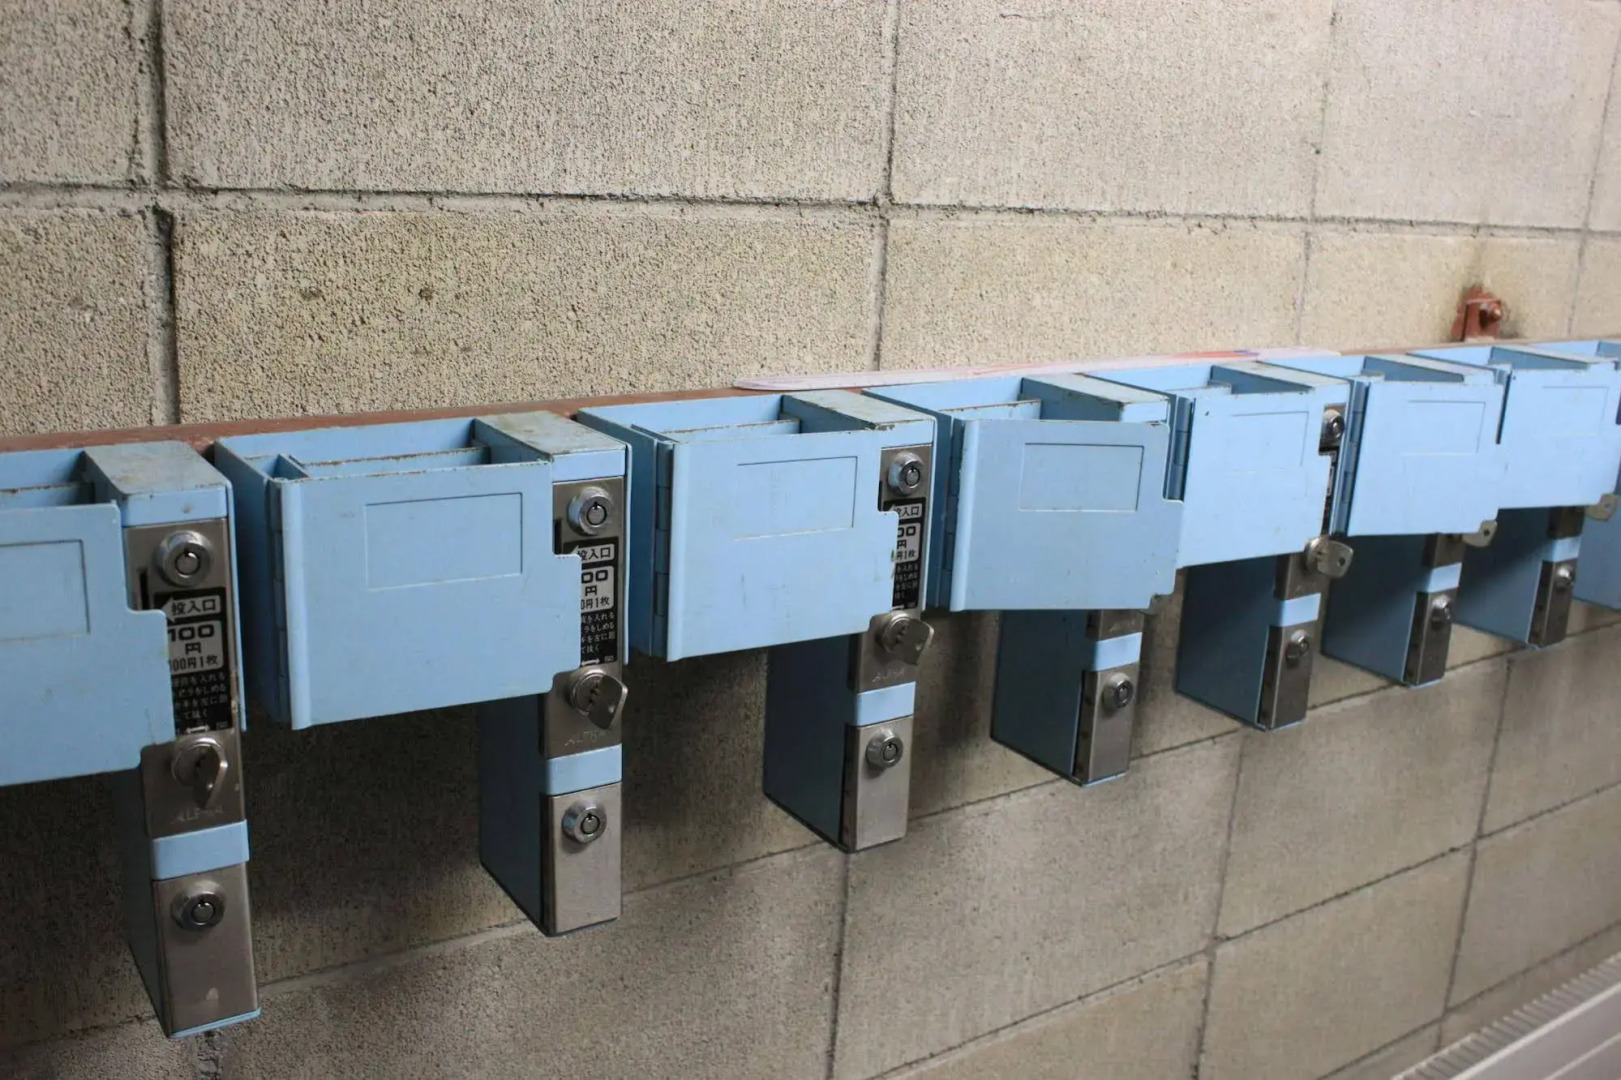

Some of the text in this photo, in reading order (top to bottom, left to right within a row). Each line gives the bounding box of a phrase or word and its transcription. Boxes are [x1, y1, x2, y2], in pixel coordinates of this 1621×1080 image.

[898, 526, 916, 537] 00
[897, 540, 906, 550] 円
[581, 570, 608, 584] 00
[585, 585, 597, 597] 円
[171, 599, 216, 615] 投入口
[581, 597, 610, 609] 0円1枚
[168, 624, 215, 642] 100
[185, 642, 202, 655] 円
[172, 654, 219, 671] 00円1枚
